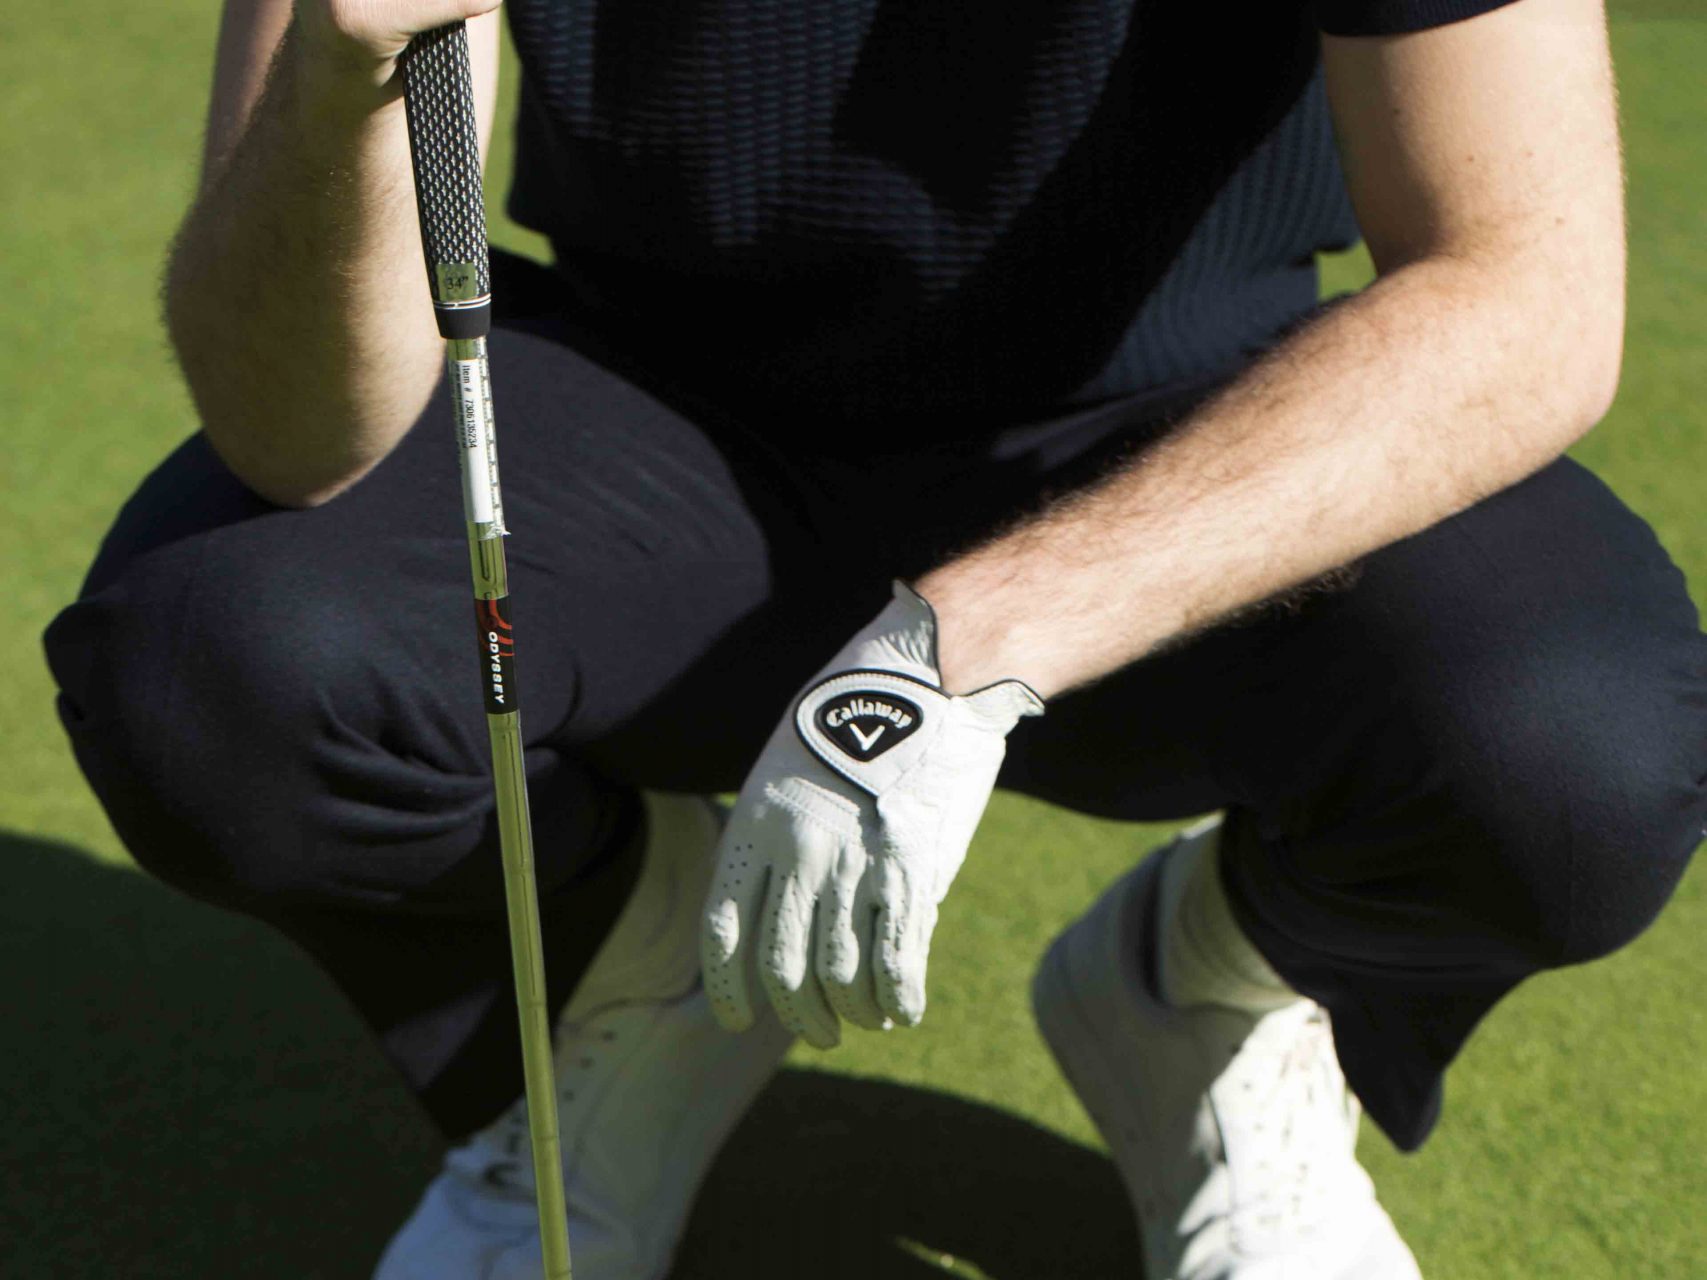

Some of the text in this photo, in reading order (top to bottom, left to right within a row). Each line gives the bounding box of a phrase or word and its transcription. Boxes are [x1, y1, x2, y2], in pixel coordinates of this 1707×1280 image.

[462, 365, 471, 384] Item
[488, 631, 505, 704] ODYSSEY
[826, 698, 913, 729] Callaway
